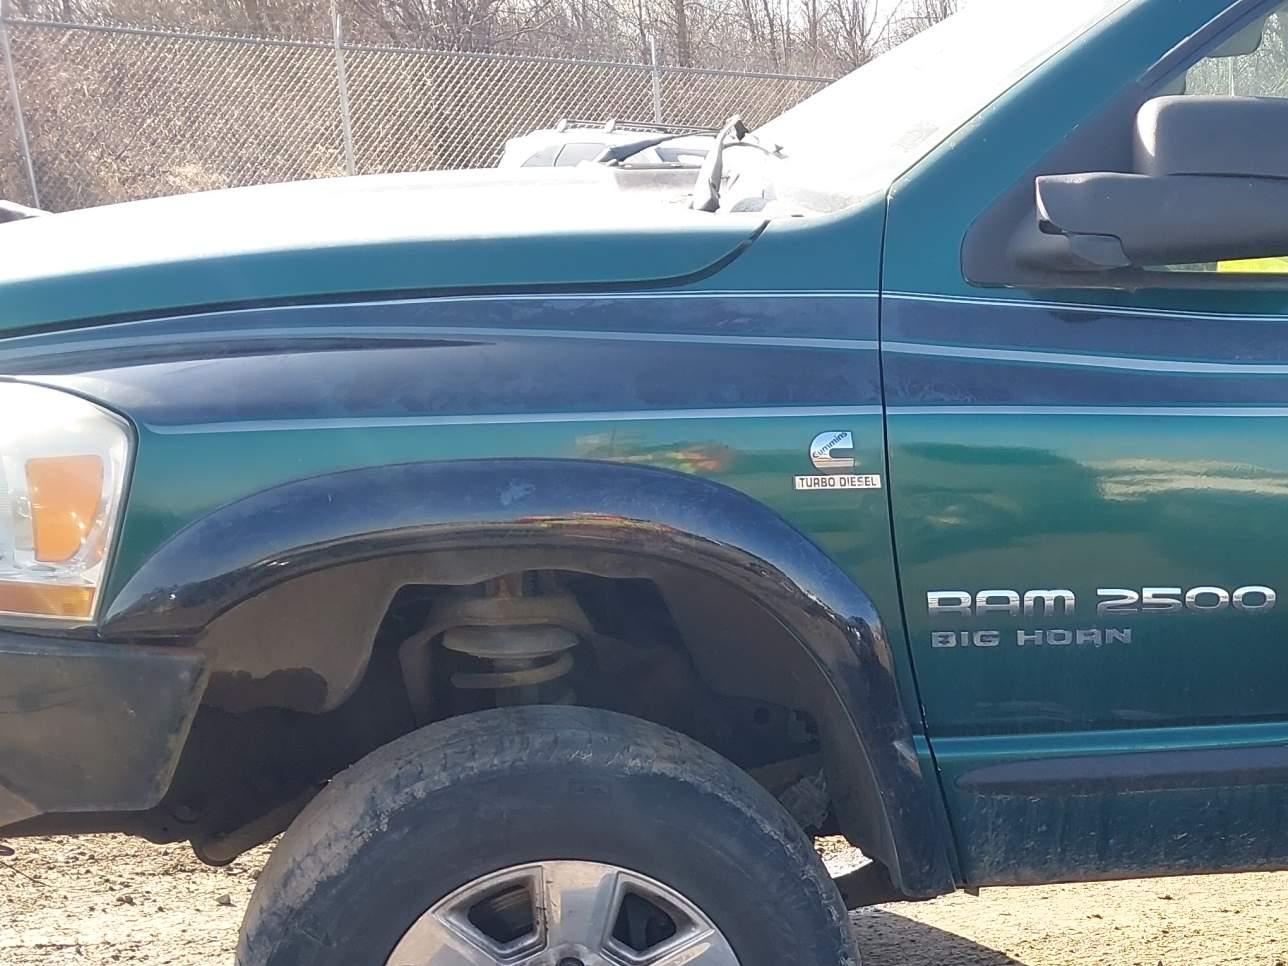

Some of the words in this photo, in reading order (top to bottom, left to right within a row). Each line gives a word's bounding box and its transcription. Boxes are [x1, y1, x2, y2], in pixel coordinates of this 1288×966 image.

[812, 431, 848, 459] Cummins
[799, 477, 835, 488] TURBO
[839, 476, 877, 487] DIESEL
[927, 589, 1076, 616] RAM
[1097, 586, 1276, 614] 2500
[931, 630, 1000, 649] BIG
[1017, 628, 1132, 647] HORN
